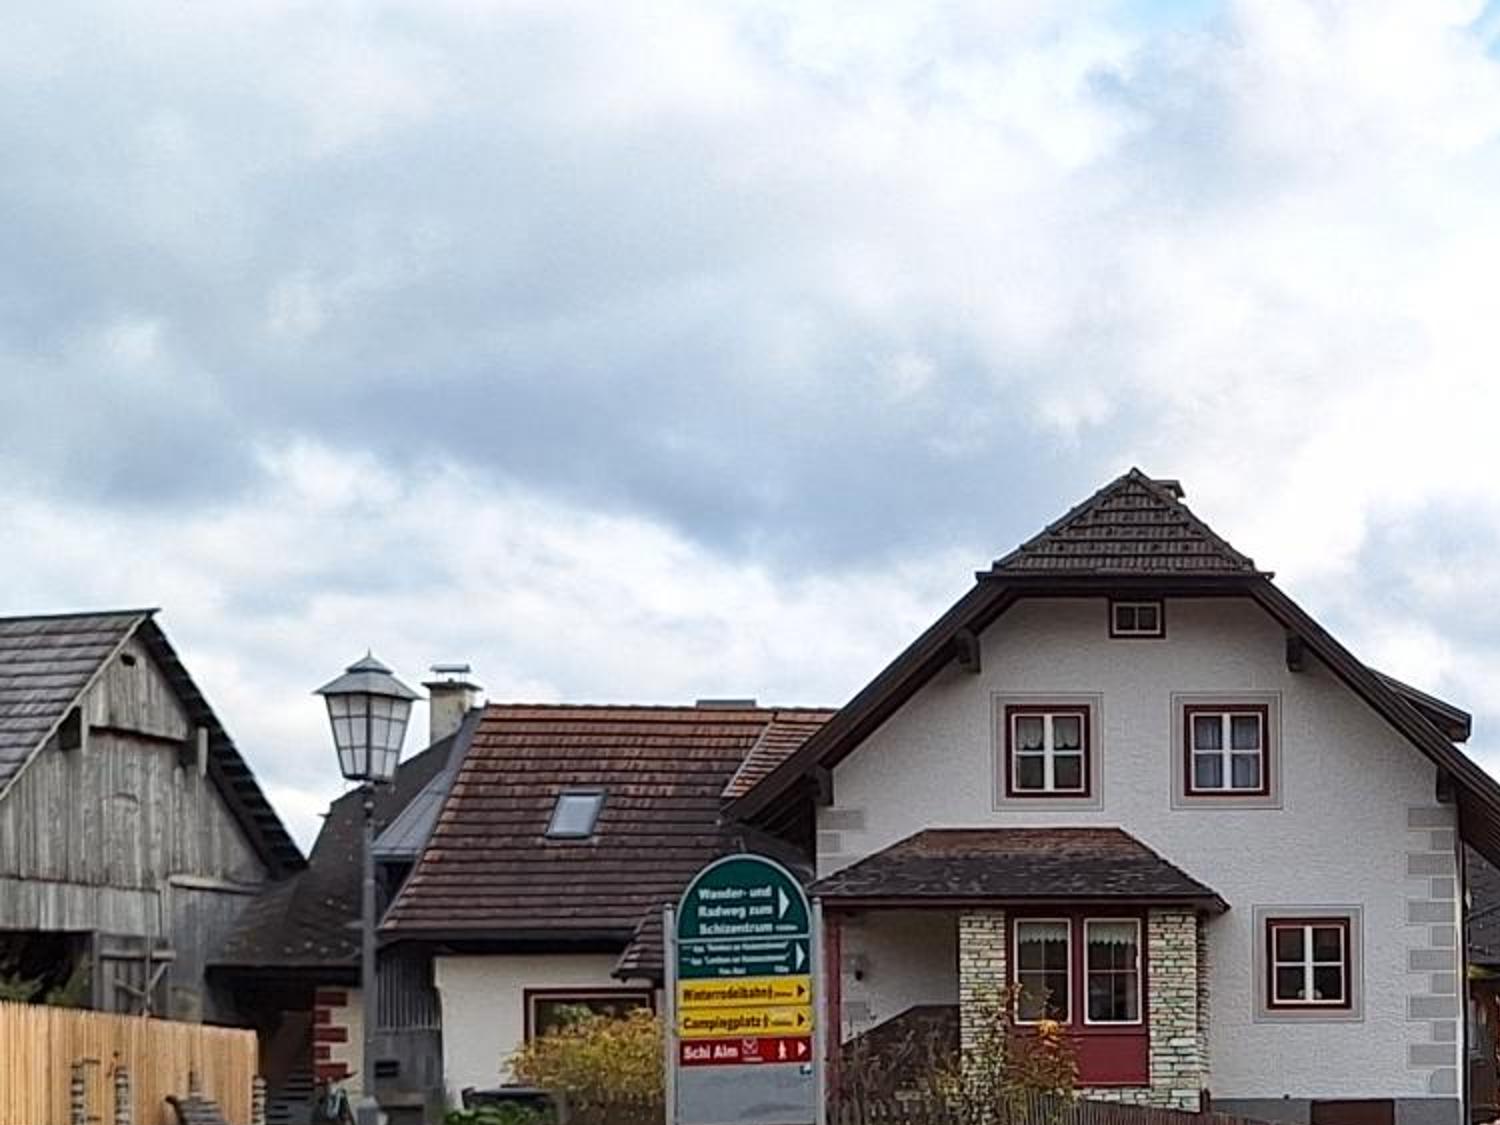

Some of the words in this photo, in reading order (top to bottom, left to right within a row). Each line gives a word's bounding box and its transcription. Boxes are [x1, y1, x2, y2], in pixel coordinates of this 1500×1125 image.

[749, 886, 772, 898] und
[698, 906, 746, 919] Radweg
[749, 906, 773, 916] zum
[683, 1015, 762, 1031] Campingplatz
